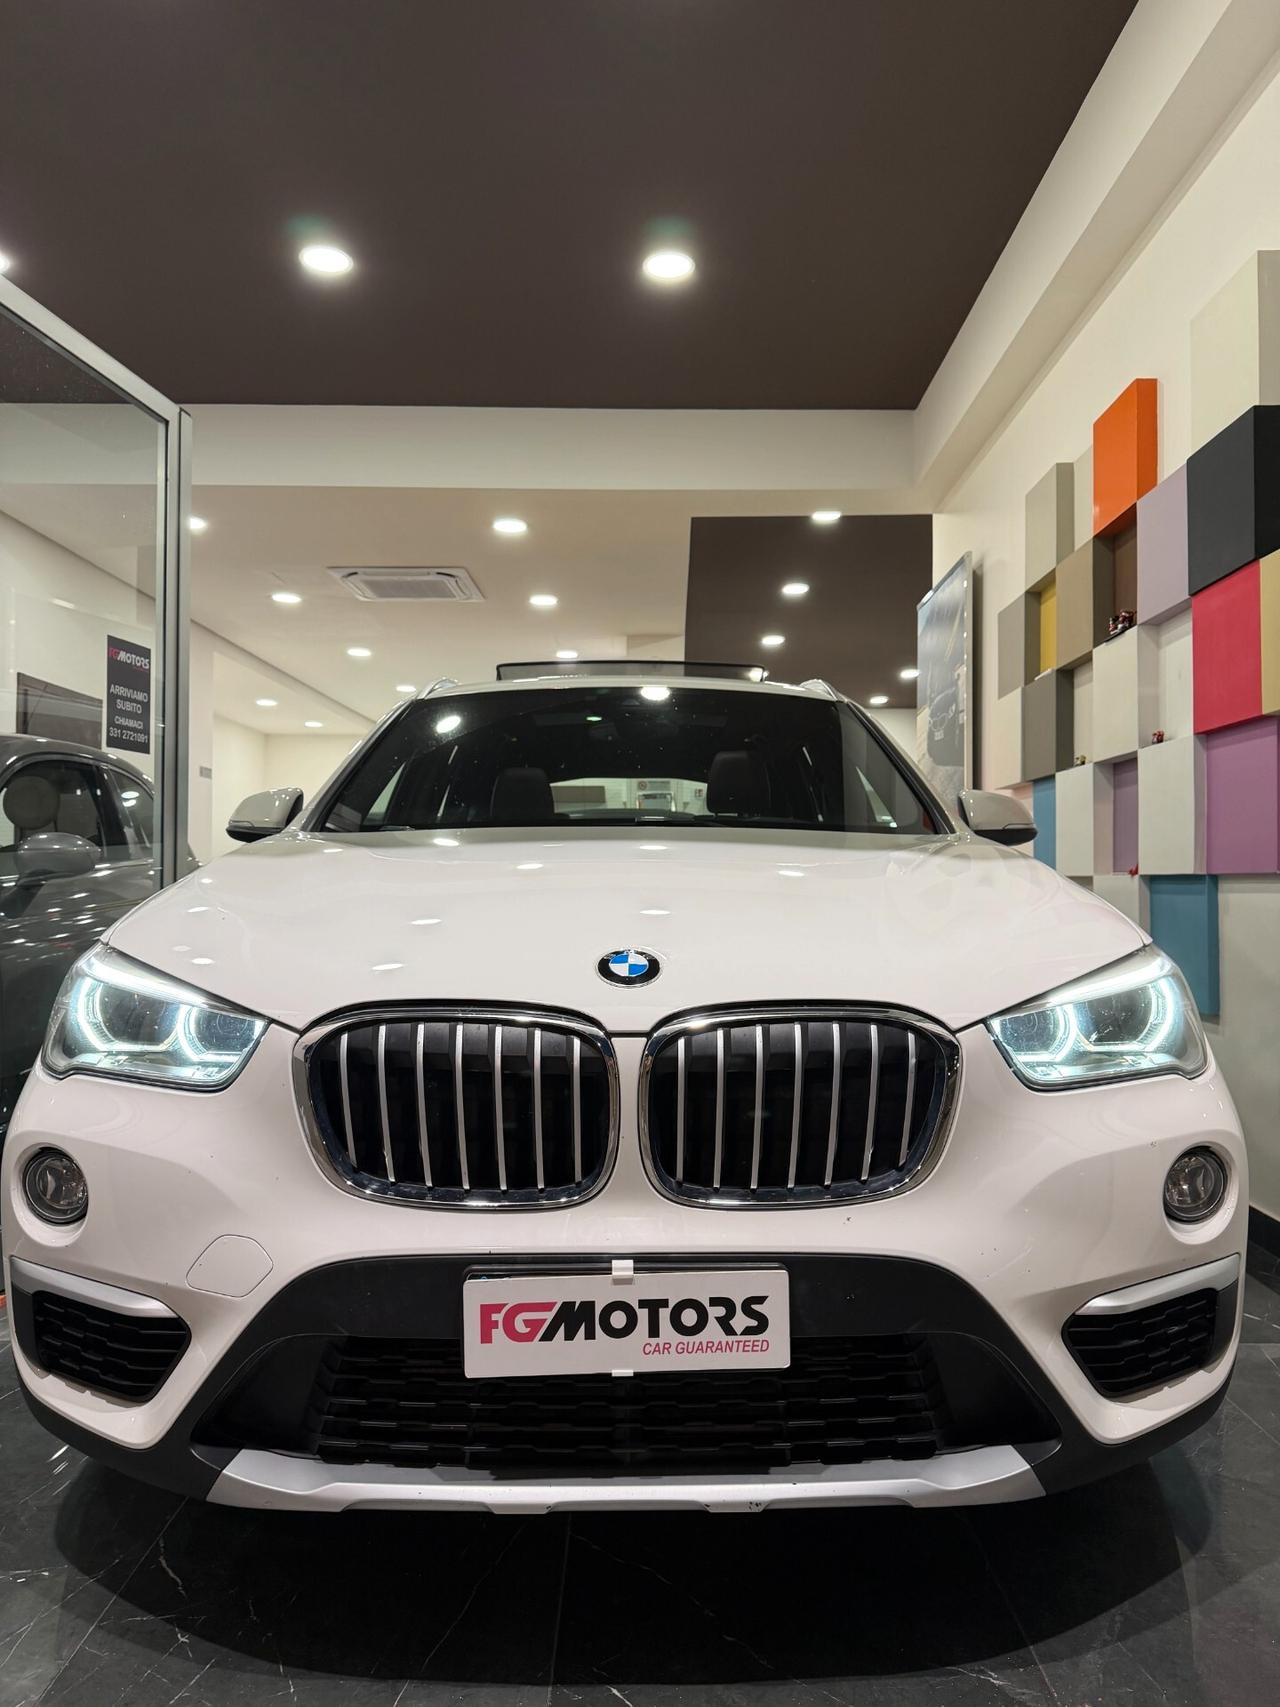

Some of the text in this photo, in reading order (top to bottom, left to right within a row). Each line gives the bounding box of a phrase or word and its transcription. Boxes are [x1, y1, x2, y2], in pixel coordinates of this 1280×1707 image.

[110, 684, 148, 702] ARRIVIAMO
[116, 699, 142, 714] SUBITO
[109, 727, 121, 738] 331
[642, 1339, 770, 1356] CAR GUARANTEED
